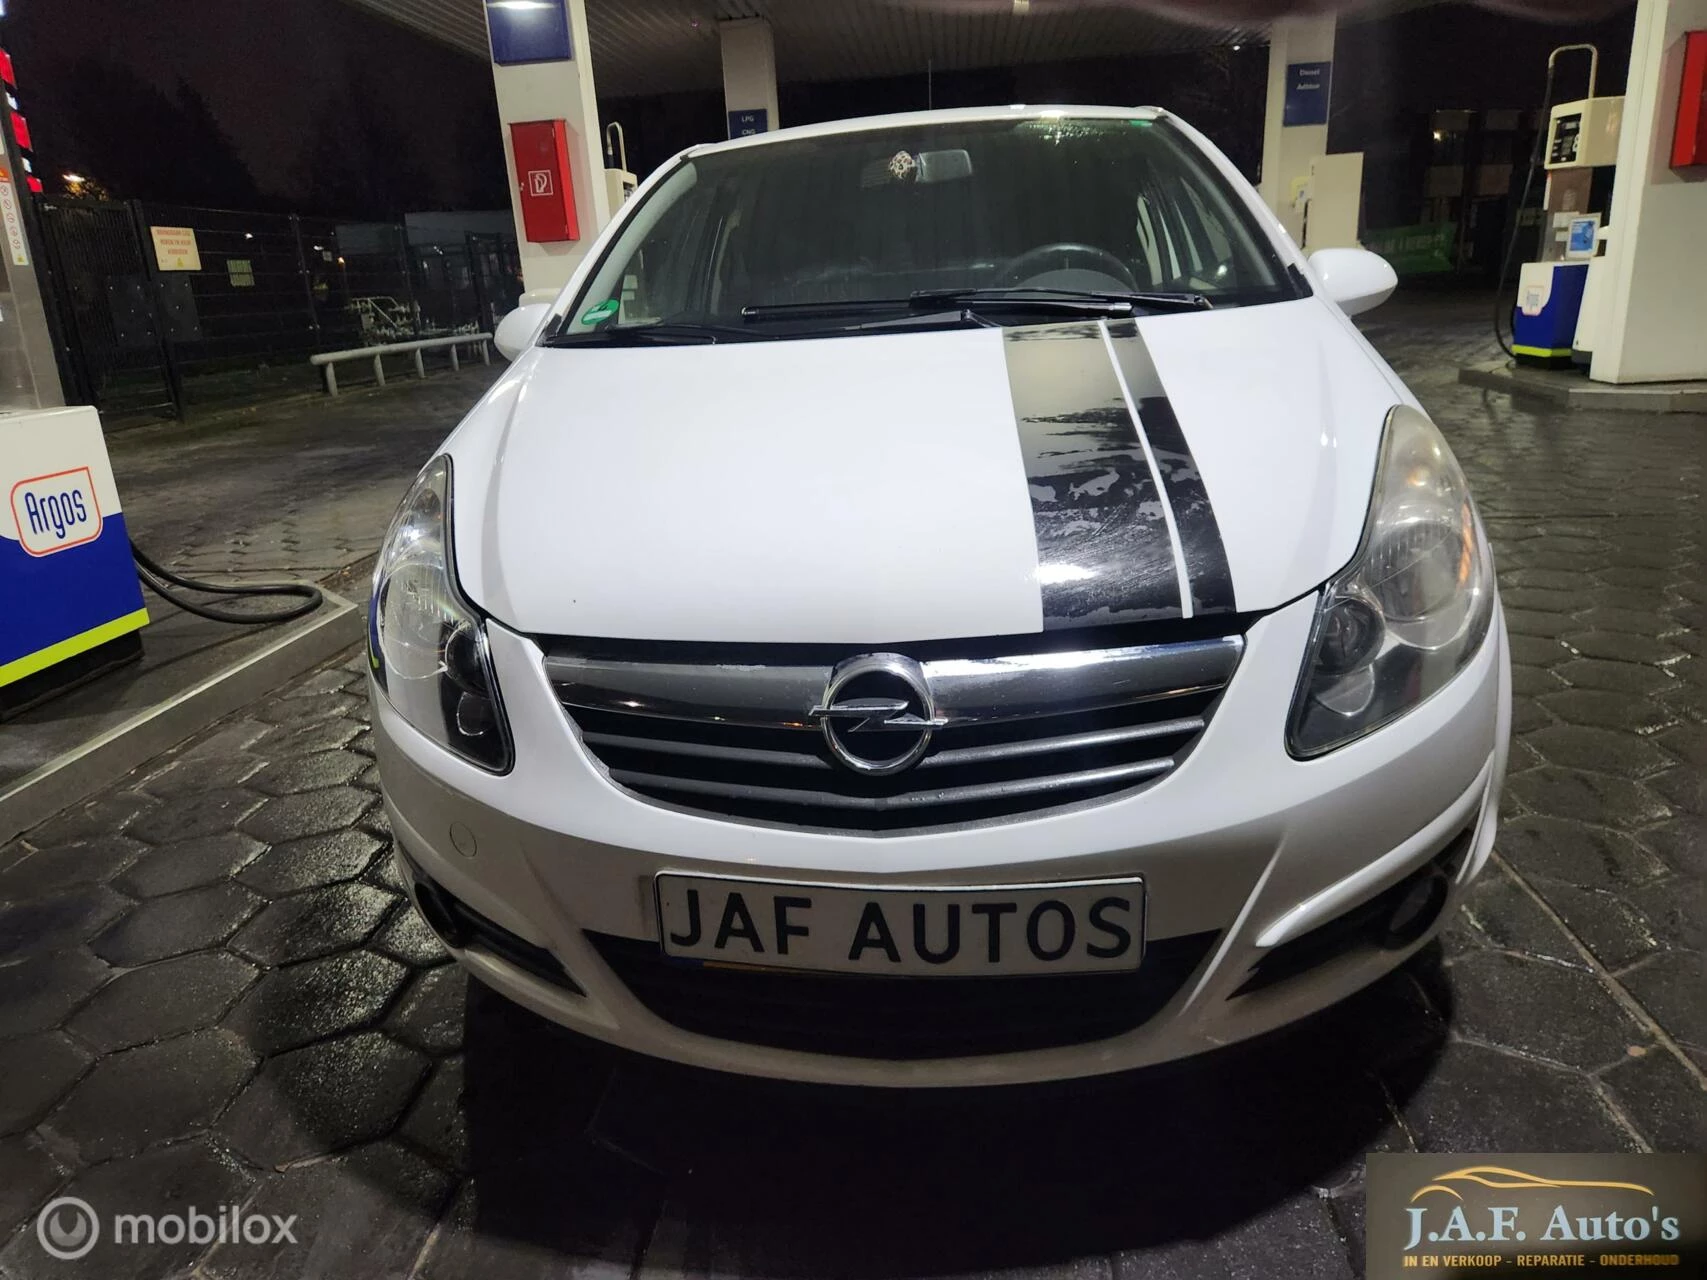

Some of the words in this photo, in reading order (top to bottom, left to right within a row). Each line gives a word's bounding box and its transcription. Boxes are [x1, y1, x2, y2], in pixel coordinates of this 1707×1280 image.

[741, 115, 755, 123] LPG
[24, 488, 87, 539] Argos
[670, 888, 813, 956] JAF
[848, 896, 1133, 964] AUTOS
